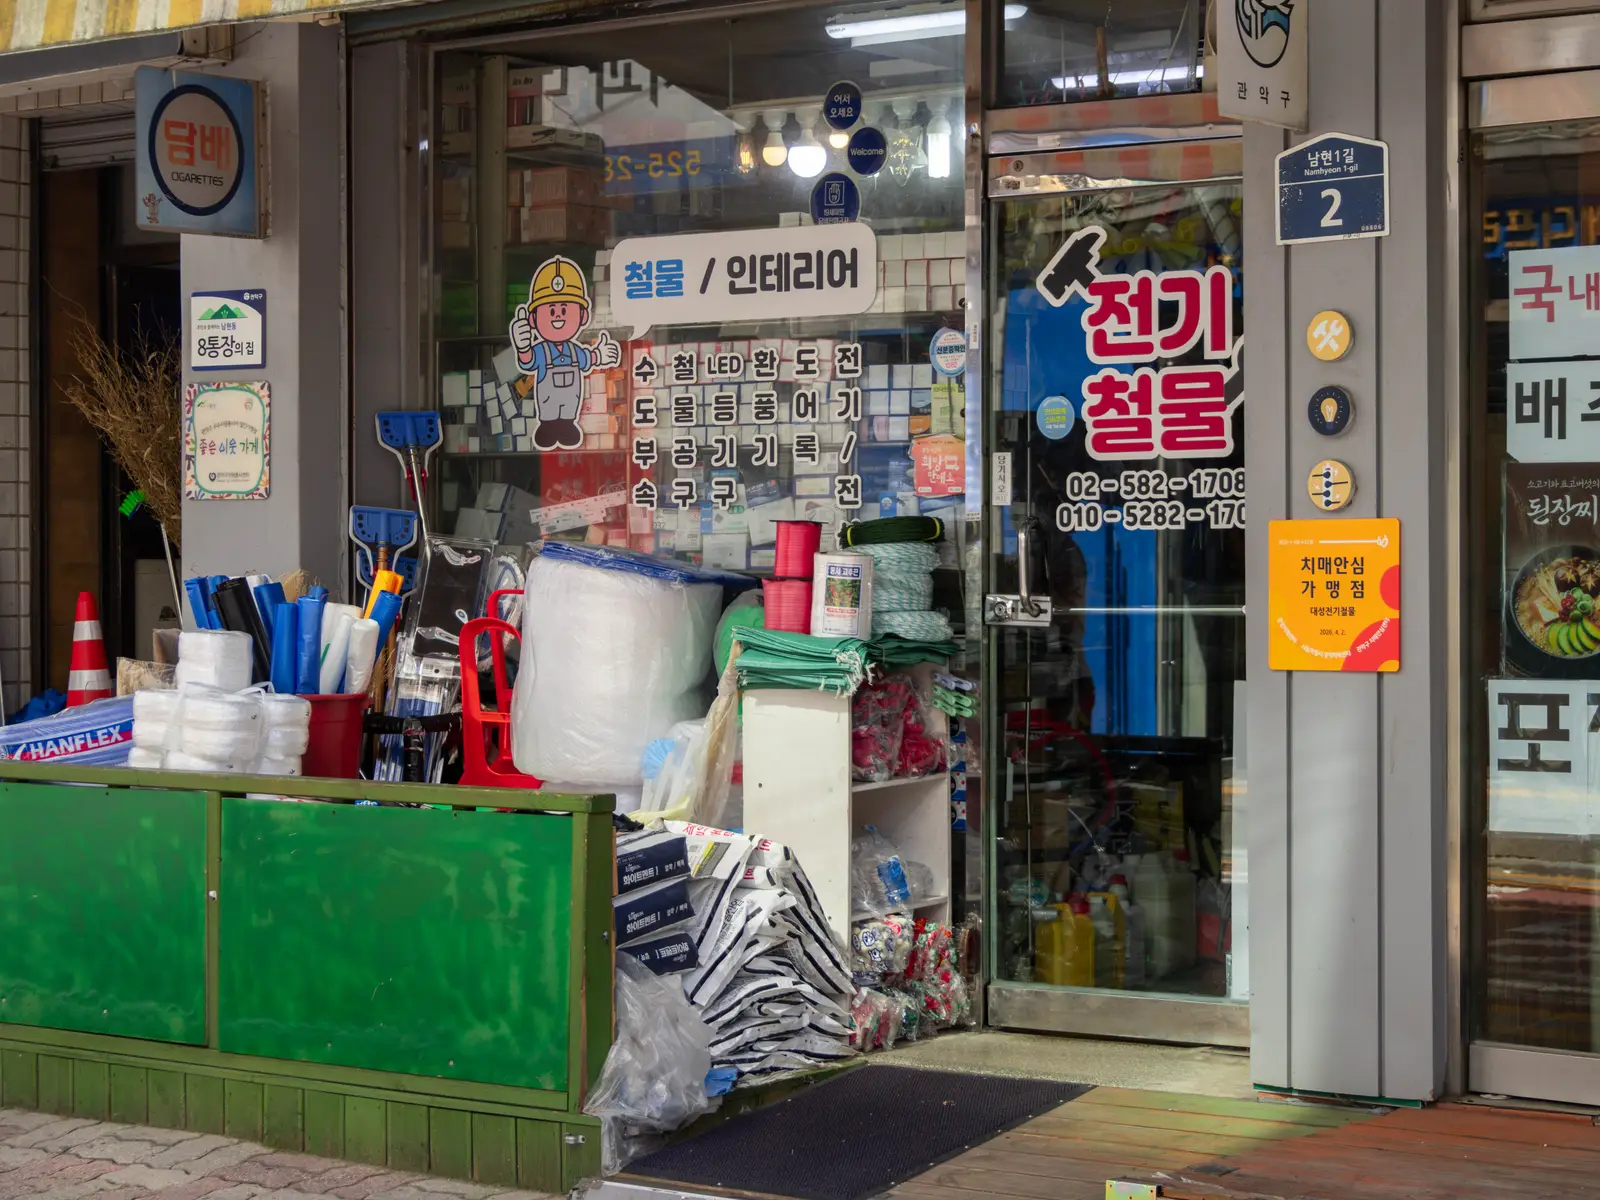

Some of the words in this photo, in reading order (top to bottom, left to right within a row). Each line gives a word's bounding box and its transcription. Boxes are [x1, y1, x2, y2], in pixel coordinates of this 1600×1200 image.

[834, 94, 851, 105] 어서
[1237, 82, 1290, 108] 관악구
[829, 107, 854, 118] 오세요
[164, 120, 231, 171] 담배
[850, 147, 884, 156] Welcome
[1307, 148, 1354, 168] 남현1길
[171, 171, 224, 187] CIGARETTES
[1304, 166, 1341, 177] Namhyeon
[1343, 164, 1358, 175] 1-gil
[1320, 188, 1343, 228] 2
[624, 258, 685, 299] 철물
[726, 247, 859, 295] 인테리어
[1087, 271, 1227, 356] 전기
[220, 322, 237, 331] 남현동
[197, 335, 244, 358] 8통장의
[245, 341, 254, 356] 집
[1087, 371, 1228, 454] 철물
[199, 439, 216, 456] 좋은
[218, 438, 237, 455] 이웃
[239, 438, 259, 455] 가게
[997, 455, 1006, 493] 당기시오
[1069, 470, 1245, 497] 02-582-1708
[1526, 479, 1559, 489] 소고기와
[1560, 478, 1600, 490] 표고버섯의
[1526, 494, 1598, 526] 된장찌
[1300, 556, 1365, 575] 치매안심
[1309, 606, 1356, 617] 대성전기철물
[29, 725, 124, 760] HANFLEX
